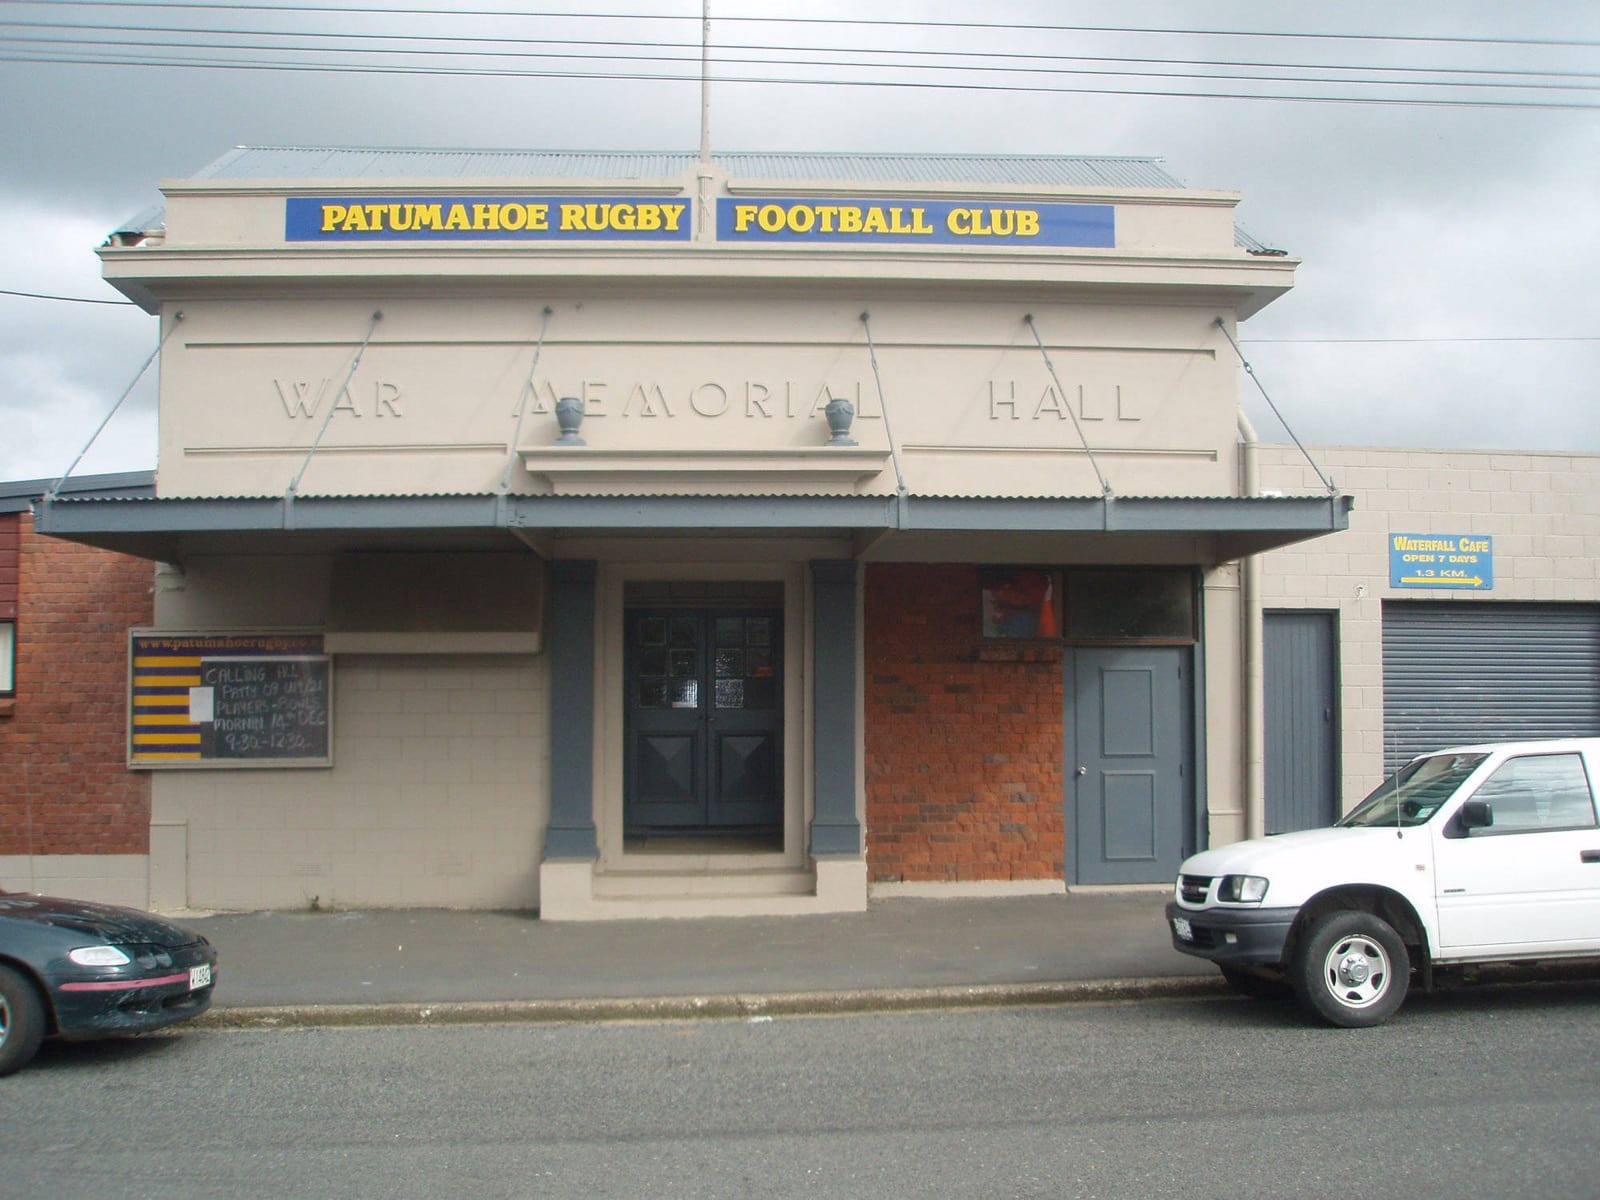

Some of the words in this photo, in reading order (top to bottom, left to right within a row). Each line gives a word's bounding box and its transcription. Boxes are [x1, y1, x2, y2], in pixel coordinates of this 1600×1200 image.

[321, 203, 549, 233] PATUMAHOE
[559, 203, 686, 232] RUGBY
[734, 204, 934, 235] FOOTBALL
[946, 208, 1041, 237] CLUB
[273, 377, 404, 419] WAR
[510, 375, 883, 419] MEMORIAL
[988, 379, 1141, 422] HALL
[1402, 553, 1435, 563] OPEN
[1438, 554, 1446, 563] 7
[1449, 555, 1479, 564] DAYS
[1415, 569, 1435, 577] 1.3
